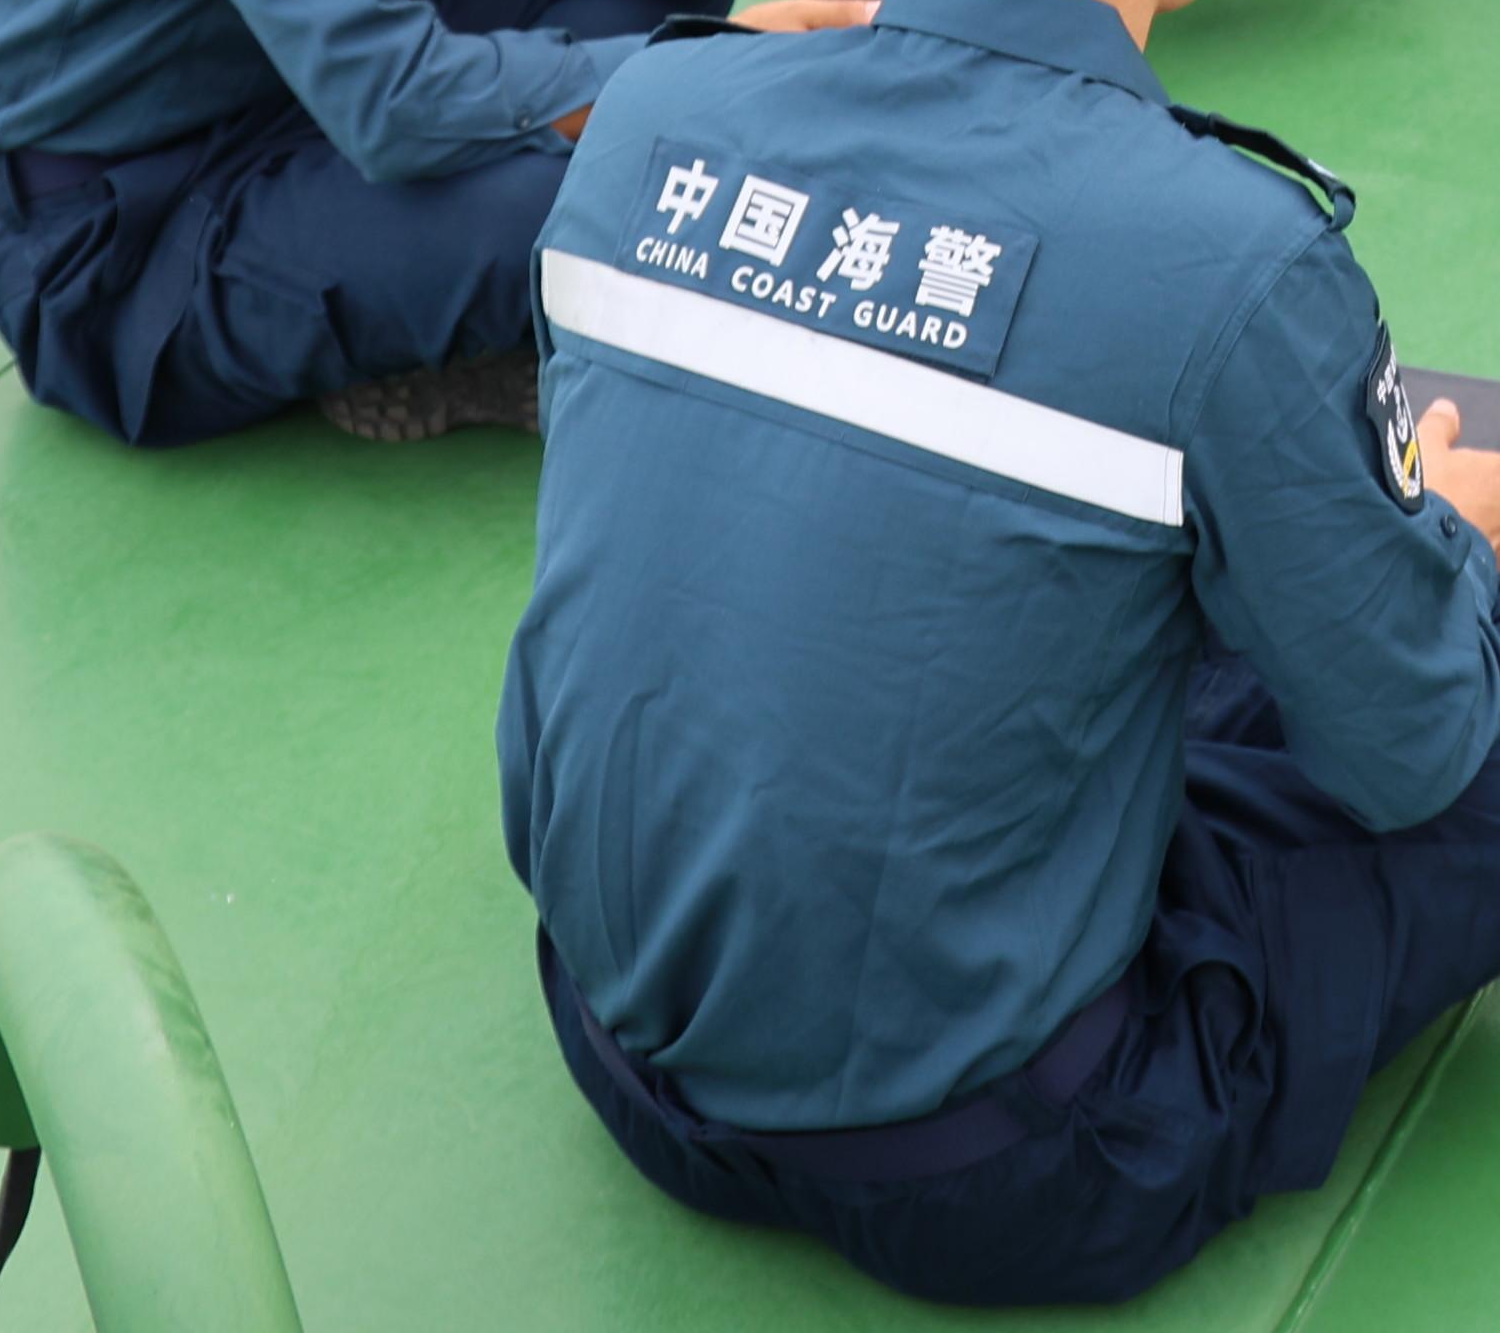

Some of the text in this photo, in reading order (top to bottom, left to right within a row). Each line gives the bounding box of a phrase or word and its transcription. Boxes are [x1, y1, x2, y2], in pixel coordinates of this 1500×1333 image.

[636, 236, 968, 350] CHINA COAST GUARD
[655, 158, 1002, 317] 中国海警
